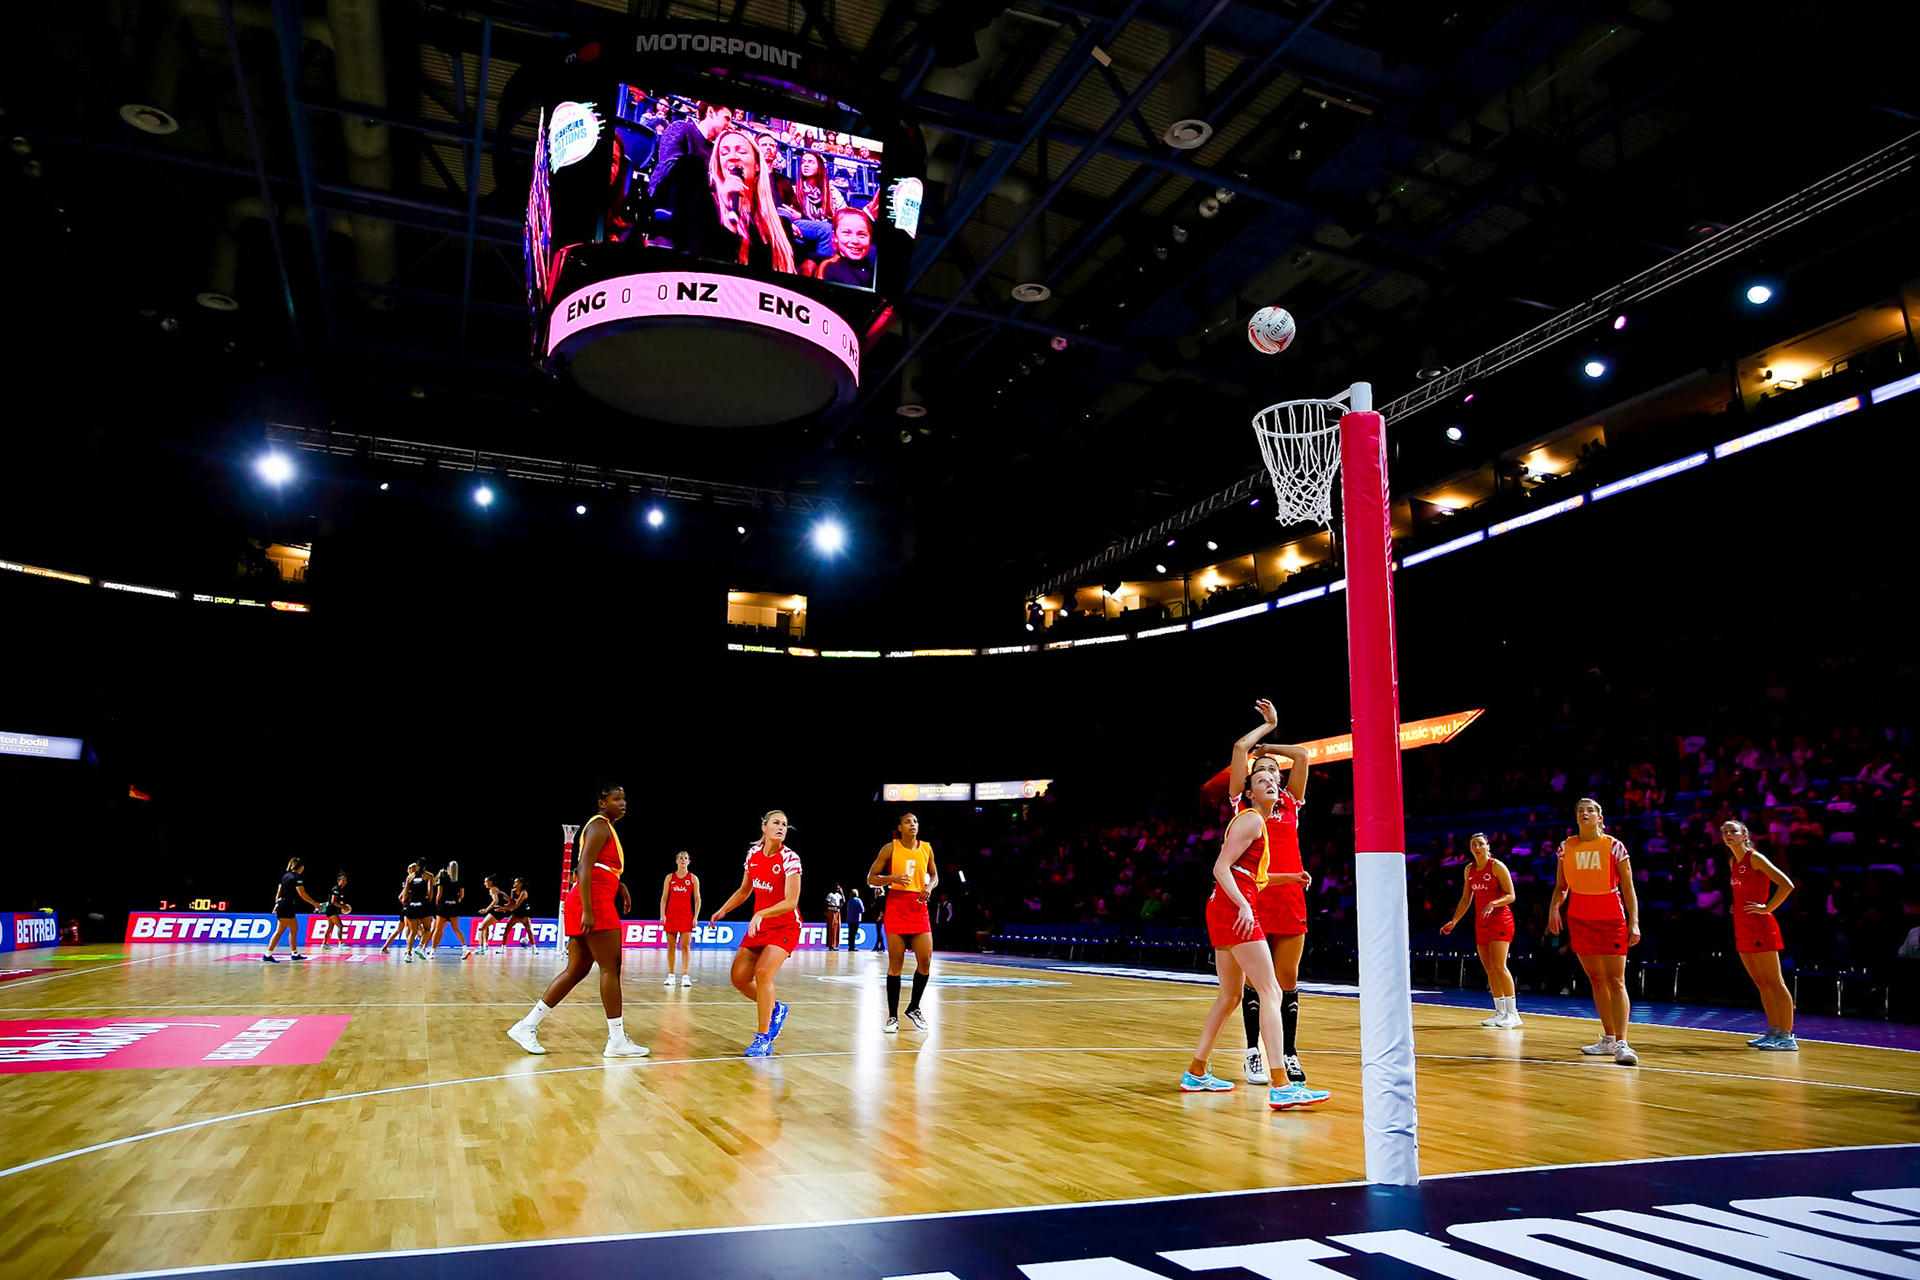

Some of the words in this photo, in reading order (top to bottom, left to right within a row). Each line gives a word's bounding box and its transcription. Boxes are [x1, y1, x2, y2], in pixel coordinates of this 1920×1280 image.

[636, 33, 801, 69] MOTORPOINT
[567, 291, 606, 323] ENG
[621, 288, 631, 304] 0
[658, 284, 668, 300] 0
[676, 282, 719, 303] NZ
[758, 291, 811, 325] ENG
[821, 319, 829, 335] 0
[841, 333, 848, 350] 0
[20, 736, 49, 748] bodill
[1431, 723, 1452, 740] you
[1575, 850, 1602, 870] WA
[16, 918, 56, 944] BETFRED
[132, 917, 272, 939] BETFRED
